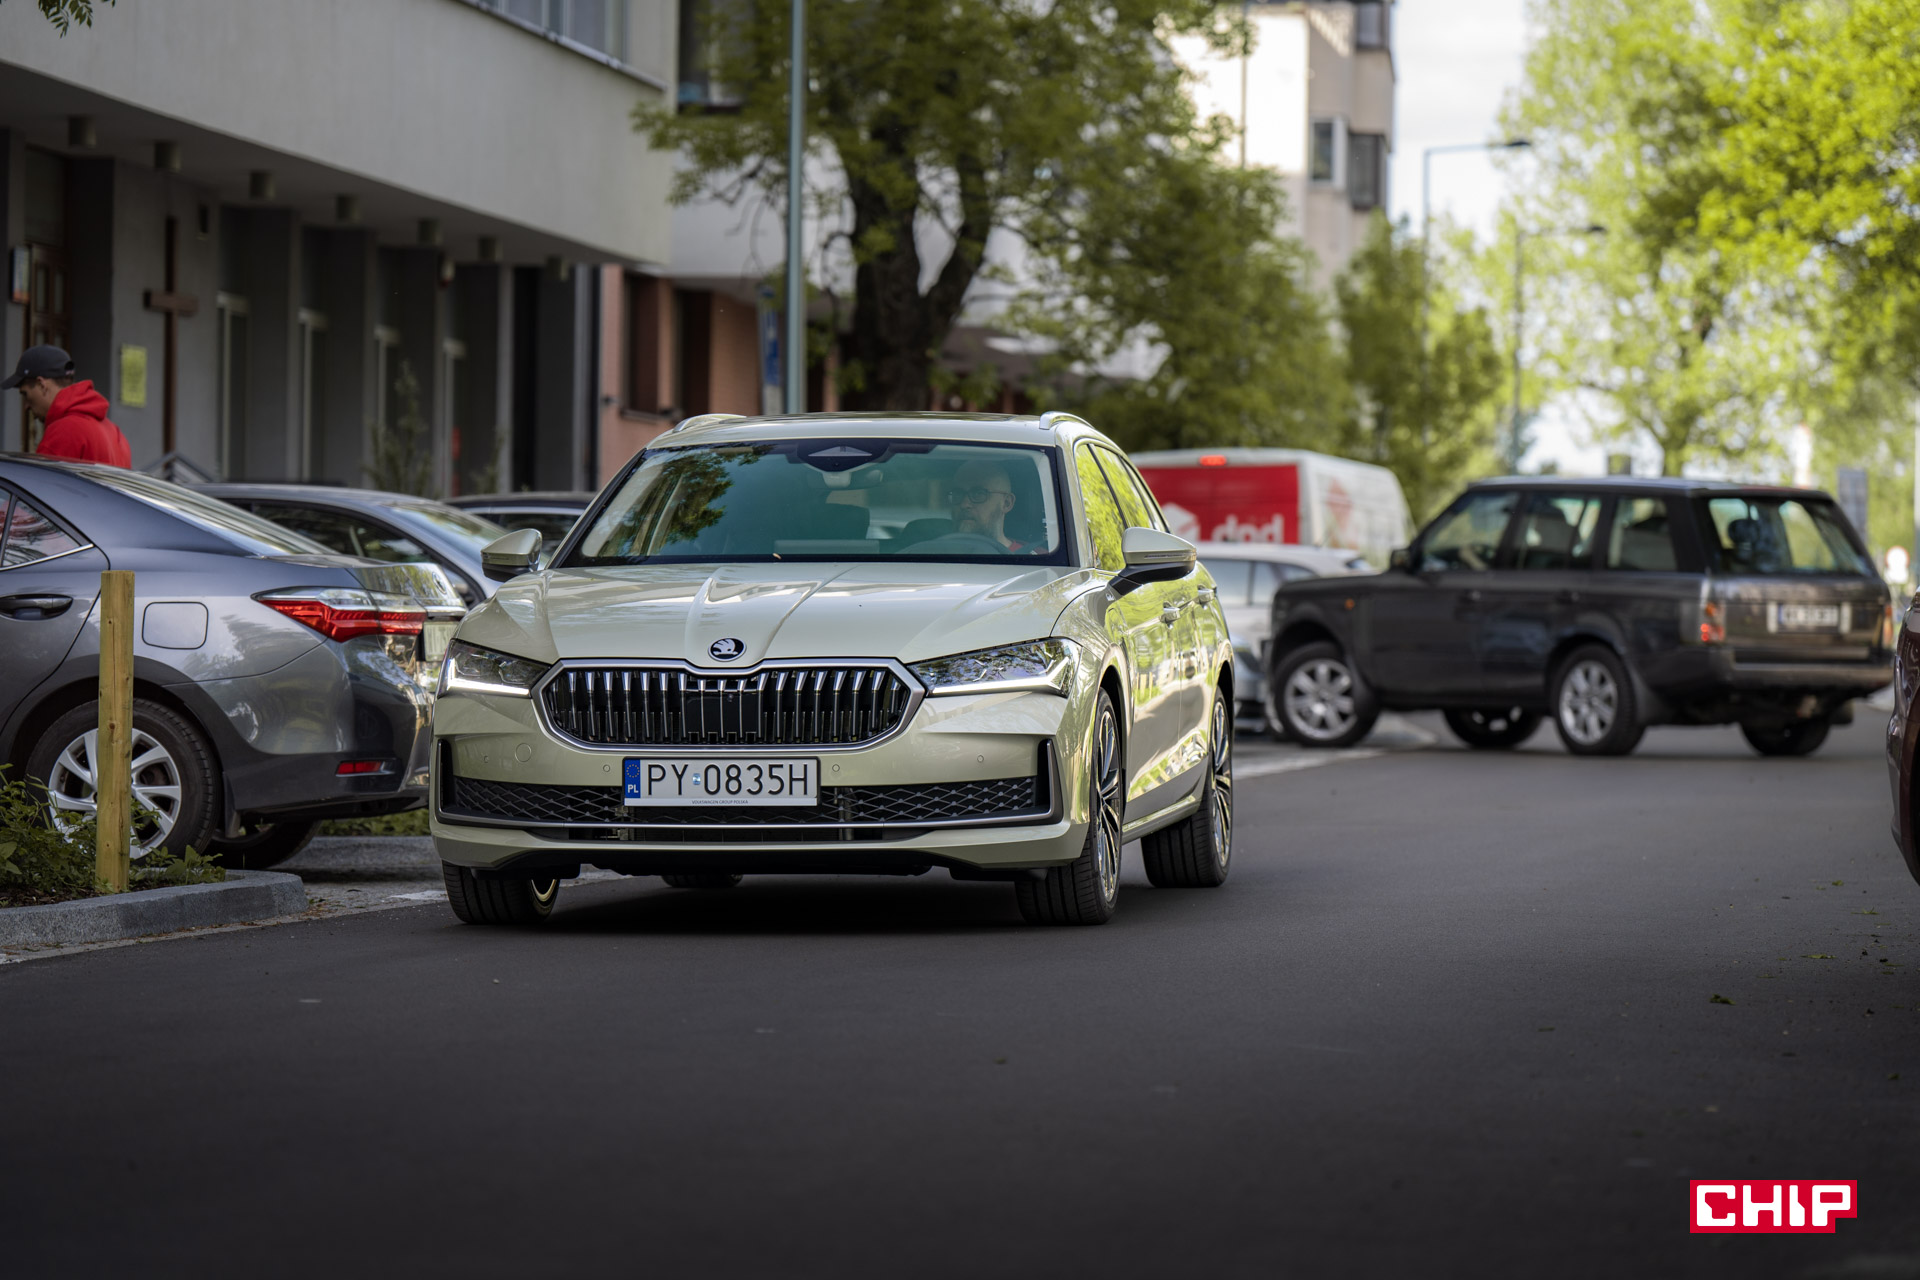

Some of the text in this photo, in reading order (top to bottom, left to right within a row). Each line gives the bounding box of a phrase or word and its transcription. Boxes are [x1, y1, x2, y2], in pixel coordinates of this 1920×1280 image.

[627, 784, 639, 794] PL
[647, 763, 808, 796] PY 0835H
